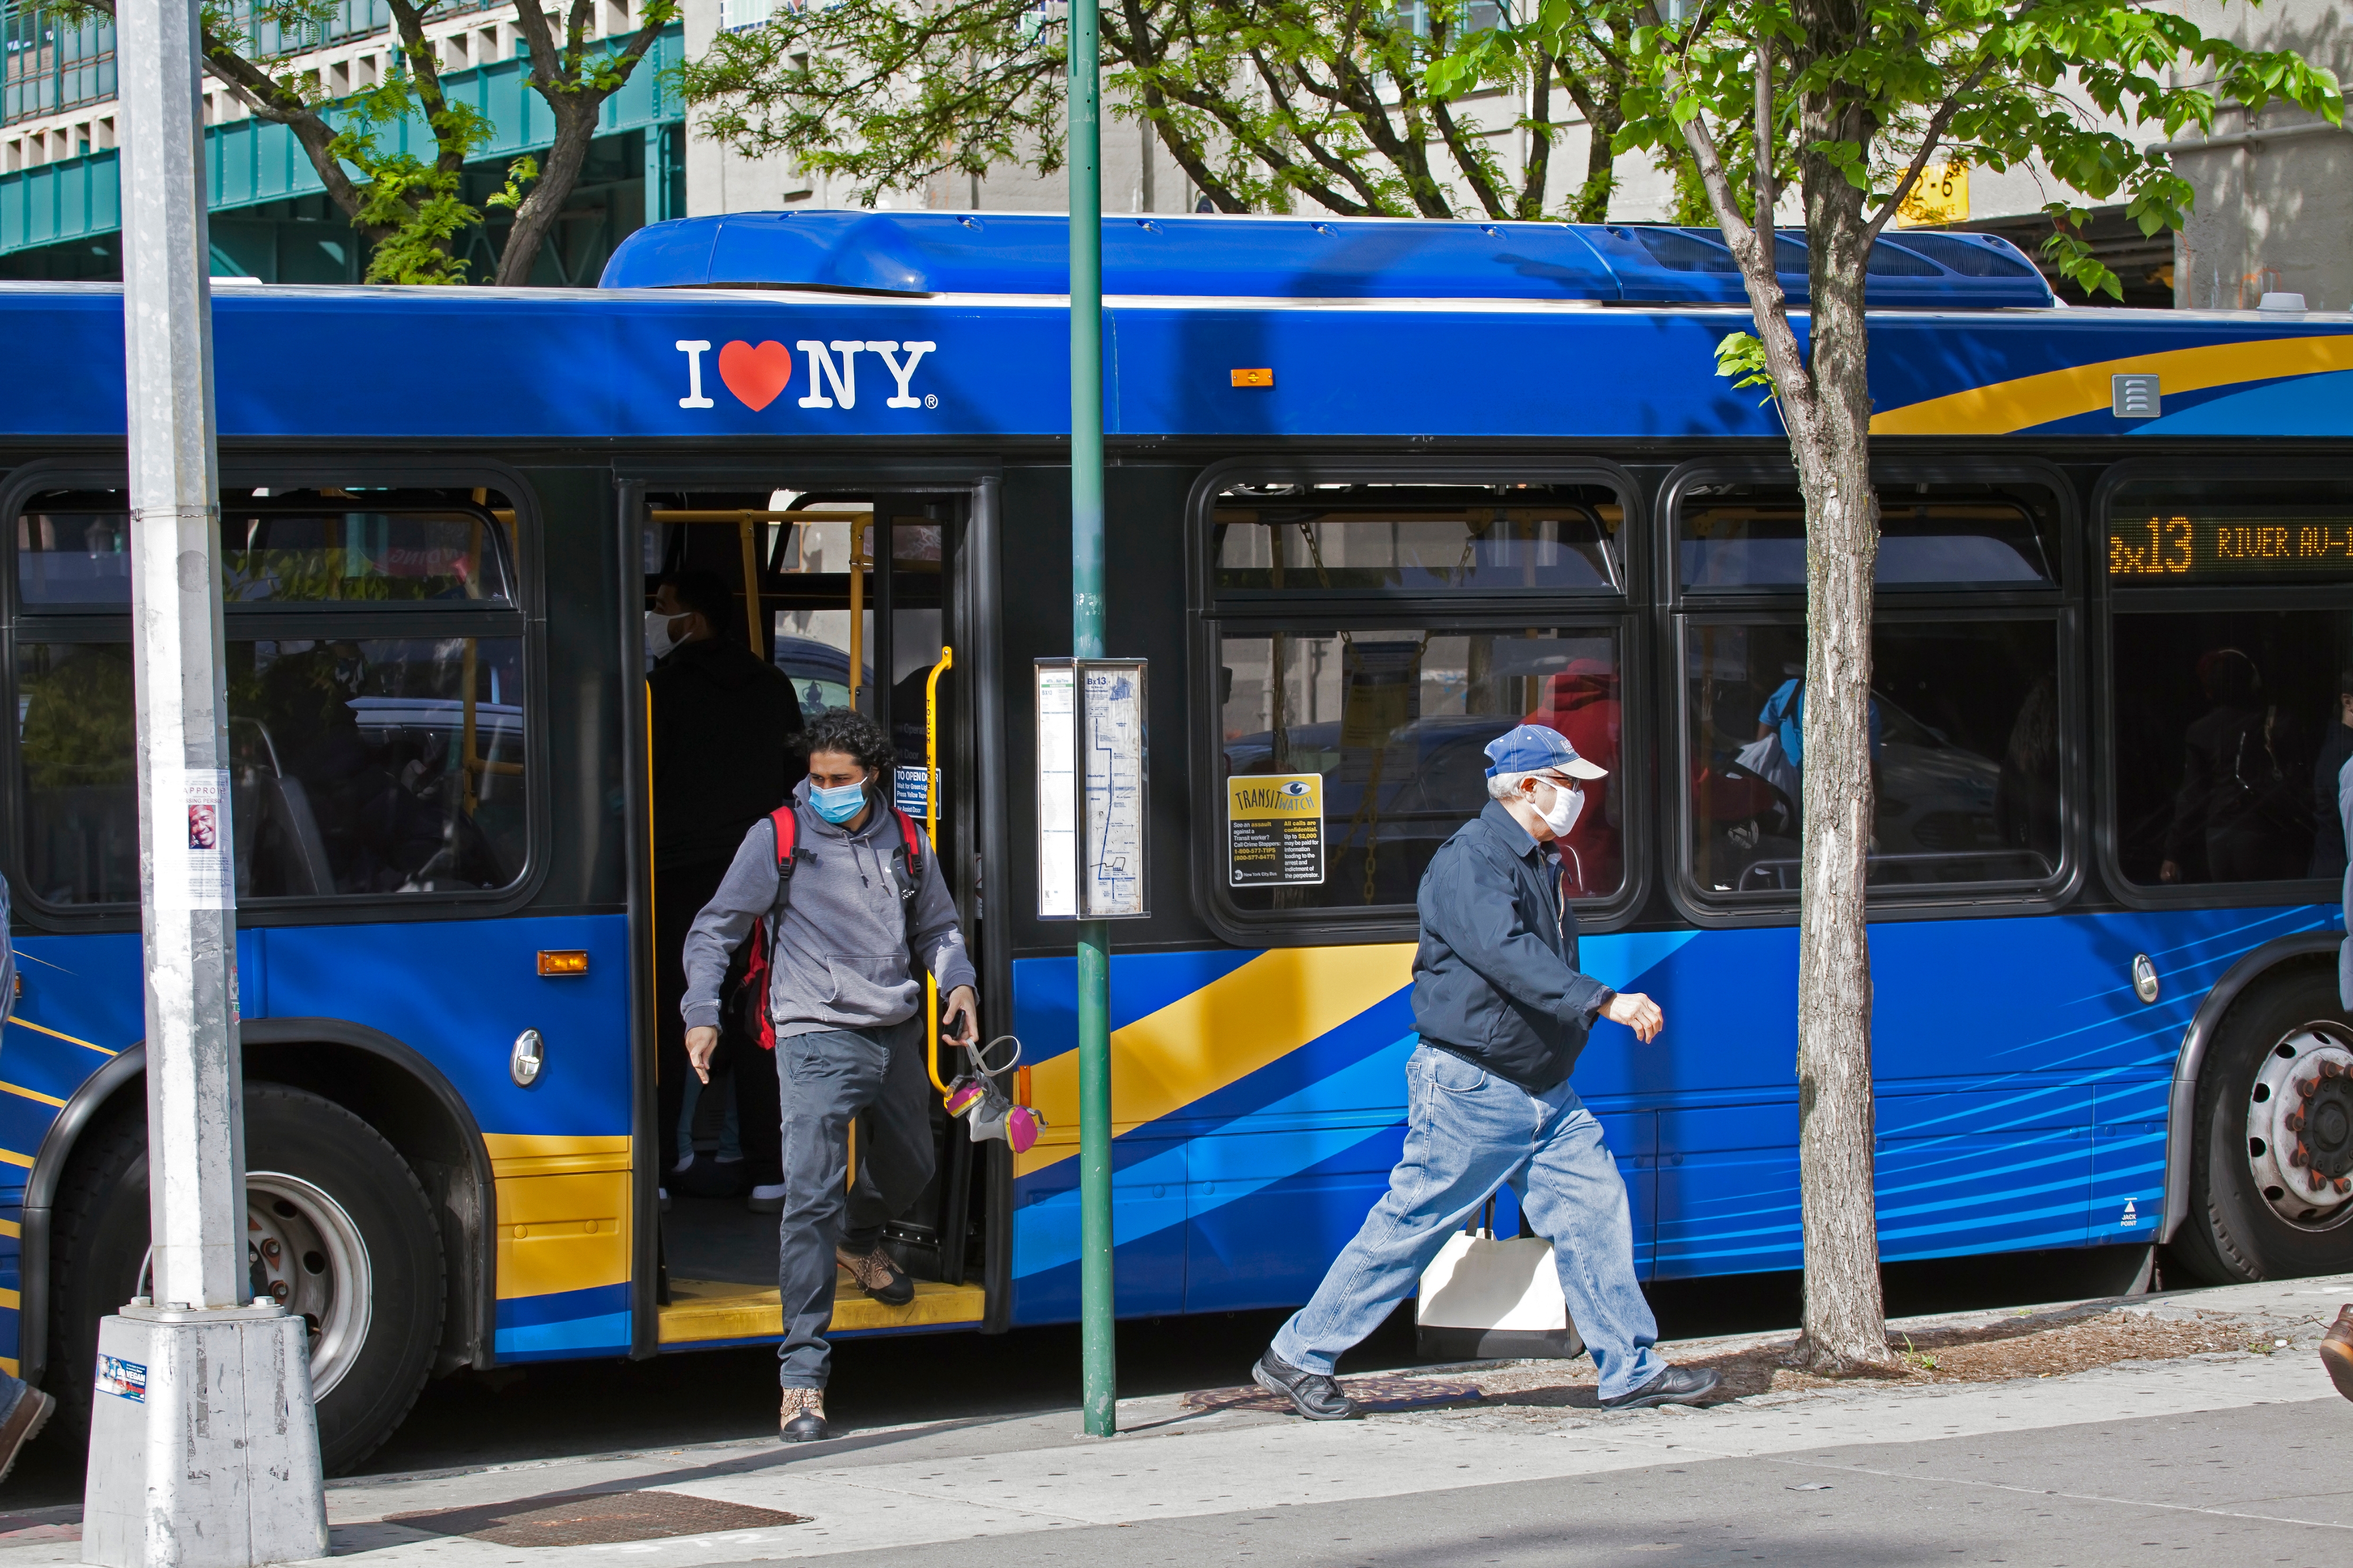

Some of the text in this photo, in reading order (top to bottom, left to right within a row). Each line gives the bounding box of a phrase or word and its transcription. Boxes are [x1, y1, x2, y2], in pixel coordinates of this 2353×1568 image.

[676, 340, 714, 409] I
[2219, 528, 2290, 557] RIVER
[1087, 677, 1106, 685] Bx13
[897, 771, 905, 781] TO
[905, 772, 921, 782] OPEN
[117, 1368, 125, 1377] GO
[126, 1370, 145, 1382] VEGAN
